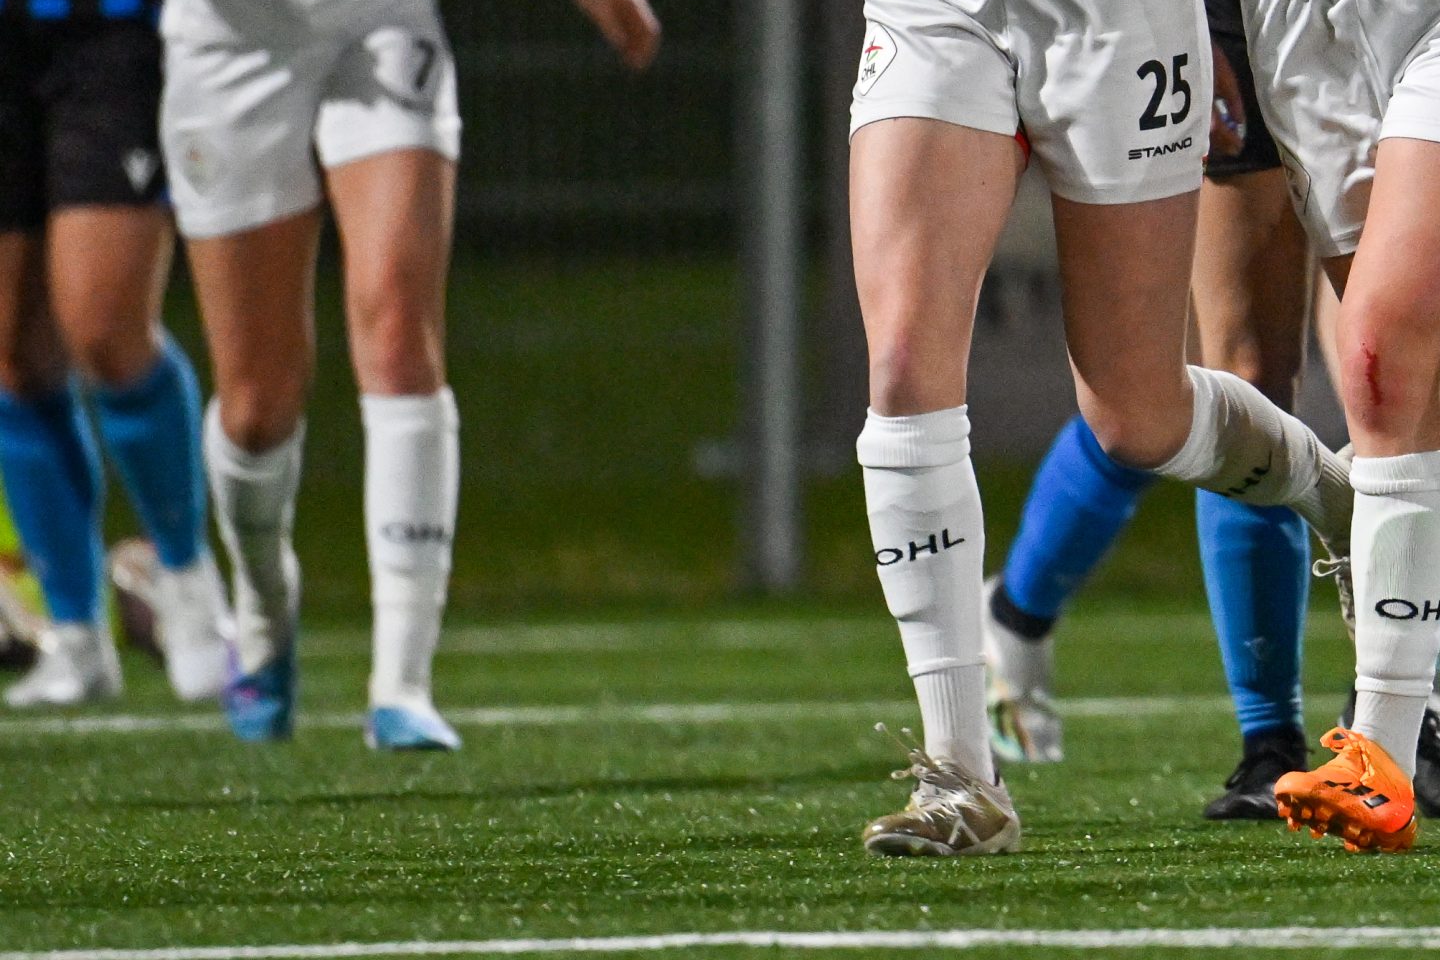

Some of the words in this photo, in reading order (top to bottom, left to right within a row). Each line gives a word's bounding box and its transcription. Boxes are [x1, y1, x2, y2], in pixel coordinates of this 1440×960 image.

[412, 39, 435, 90] 7
[1136, 53, 1191, 131] 25
[1128, 137, 1192, 160] STANNO
[876, 528, 965, 566] OHL
